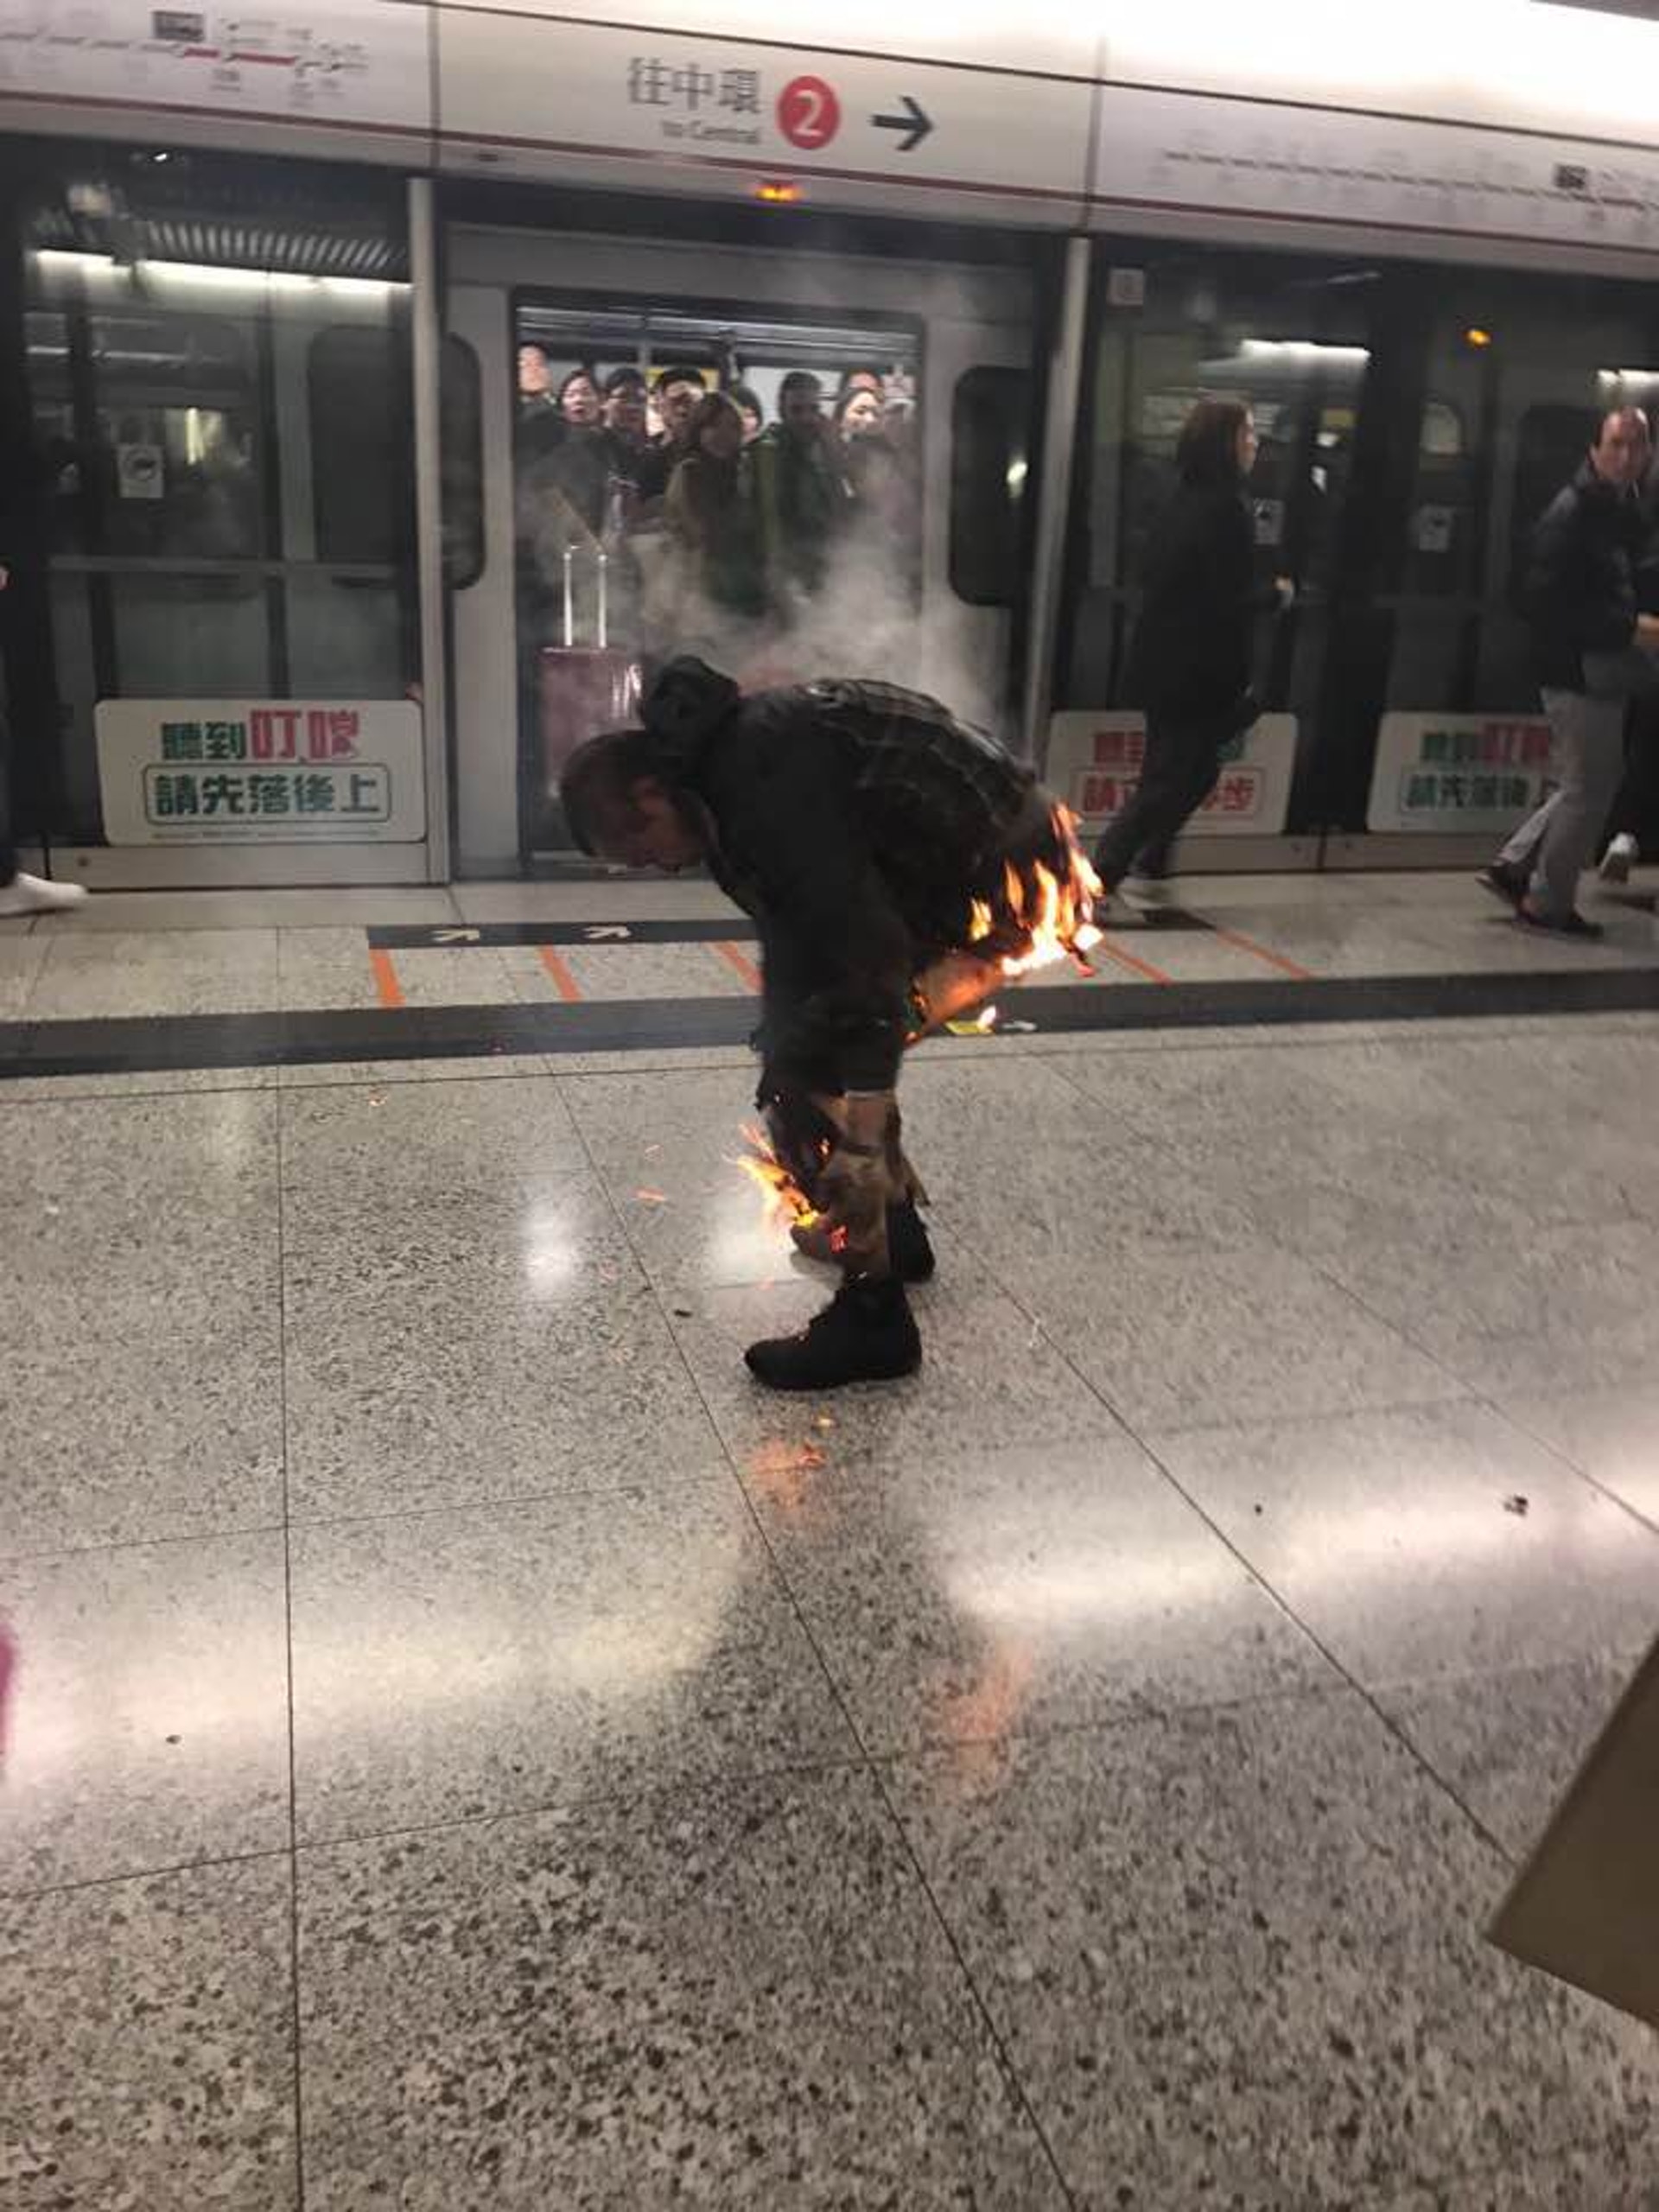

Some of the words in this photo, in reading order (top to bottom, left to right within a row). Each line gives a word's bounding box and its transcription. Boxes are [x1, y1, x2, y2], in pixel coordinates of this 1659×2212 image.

[627, 56, 761, 114] 往中環
[792, 90, 825, 137] 2
[155, 773, 379, 817] 請先落後上
